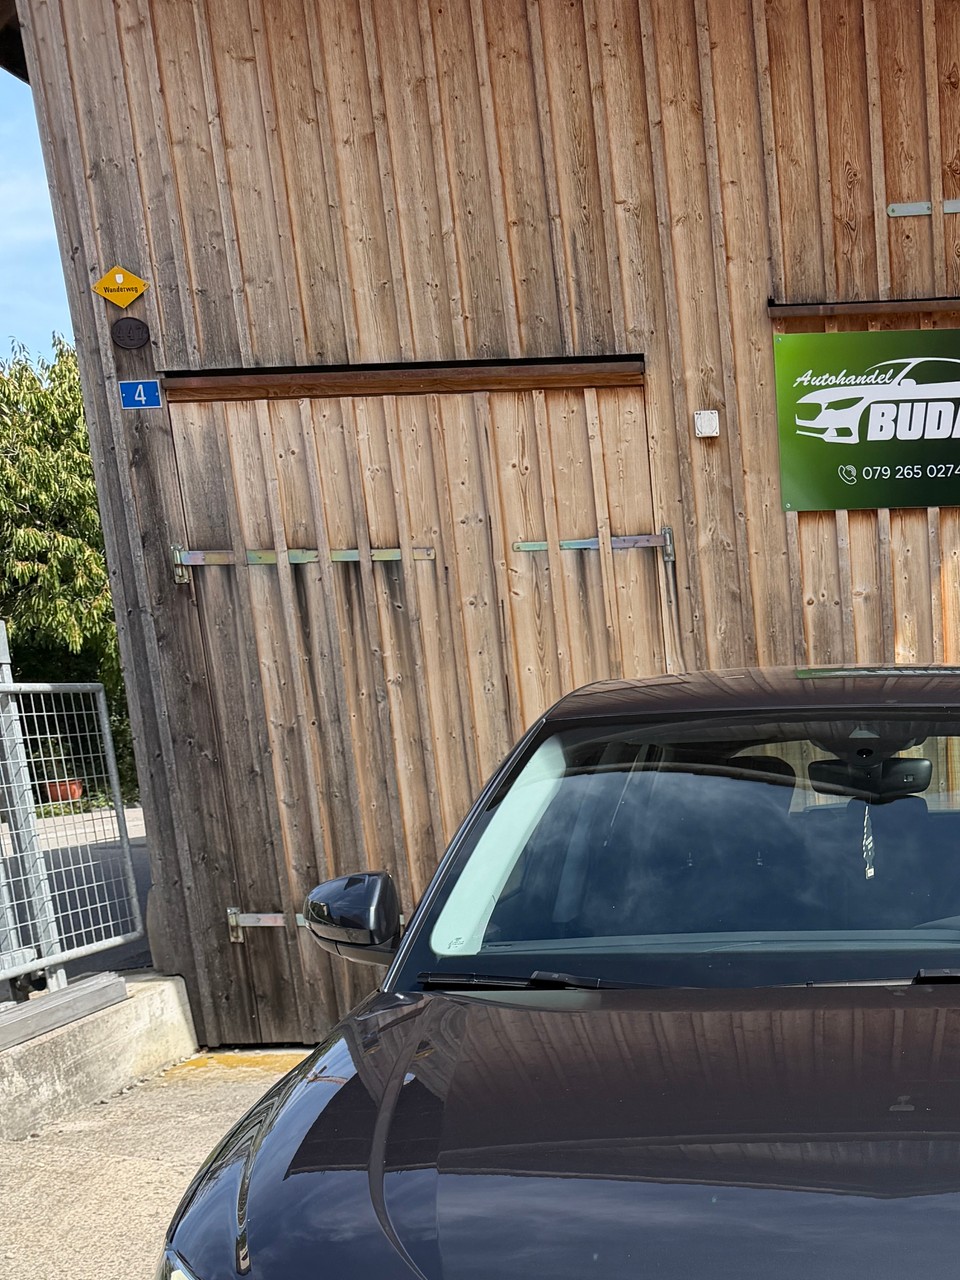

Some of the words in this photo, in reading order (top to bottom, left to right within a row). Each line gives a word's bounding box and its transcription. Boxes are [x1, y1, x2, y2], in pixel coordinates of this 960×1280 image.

[103, 286, 139, 294] Wanderweg
[793, 369, 894, 388] Autohandel
[134, 384, 147, 405] 4
[862, 466, 891, 480] 079
[895, 465, 922, 479] 265
